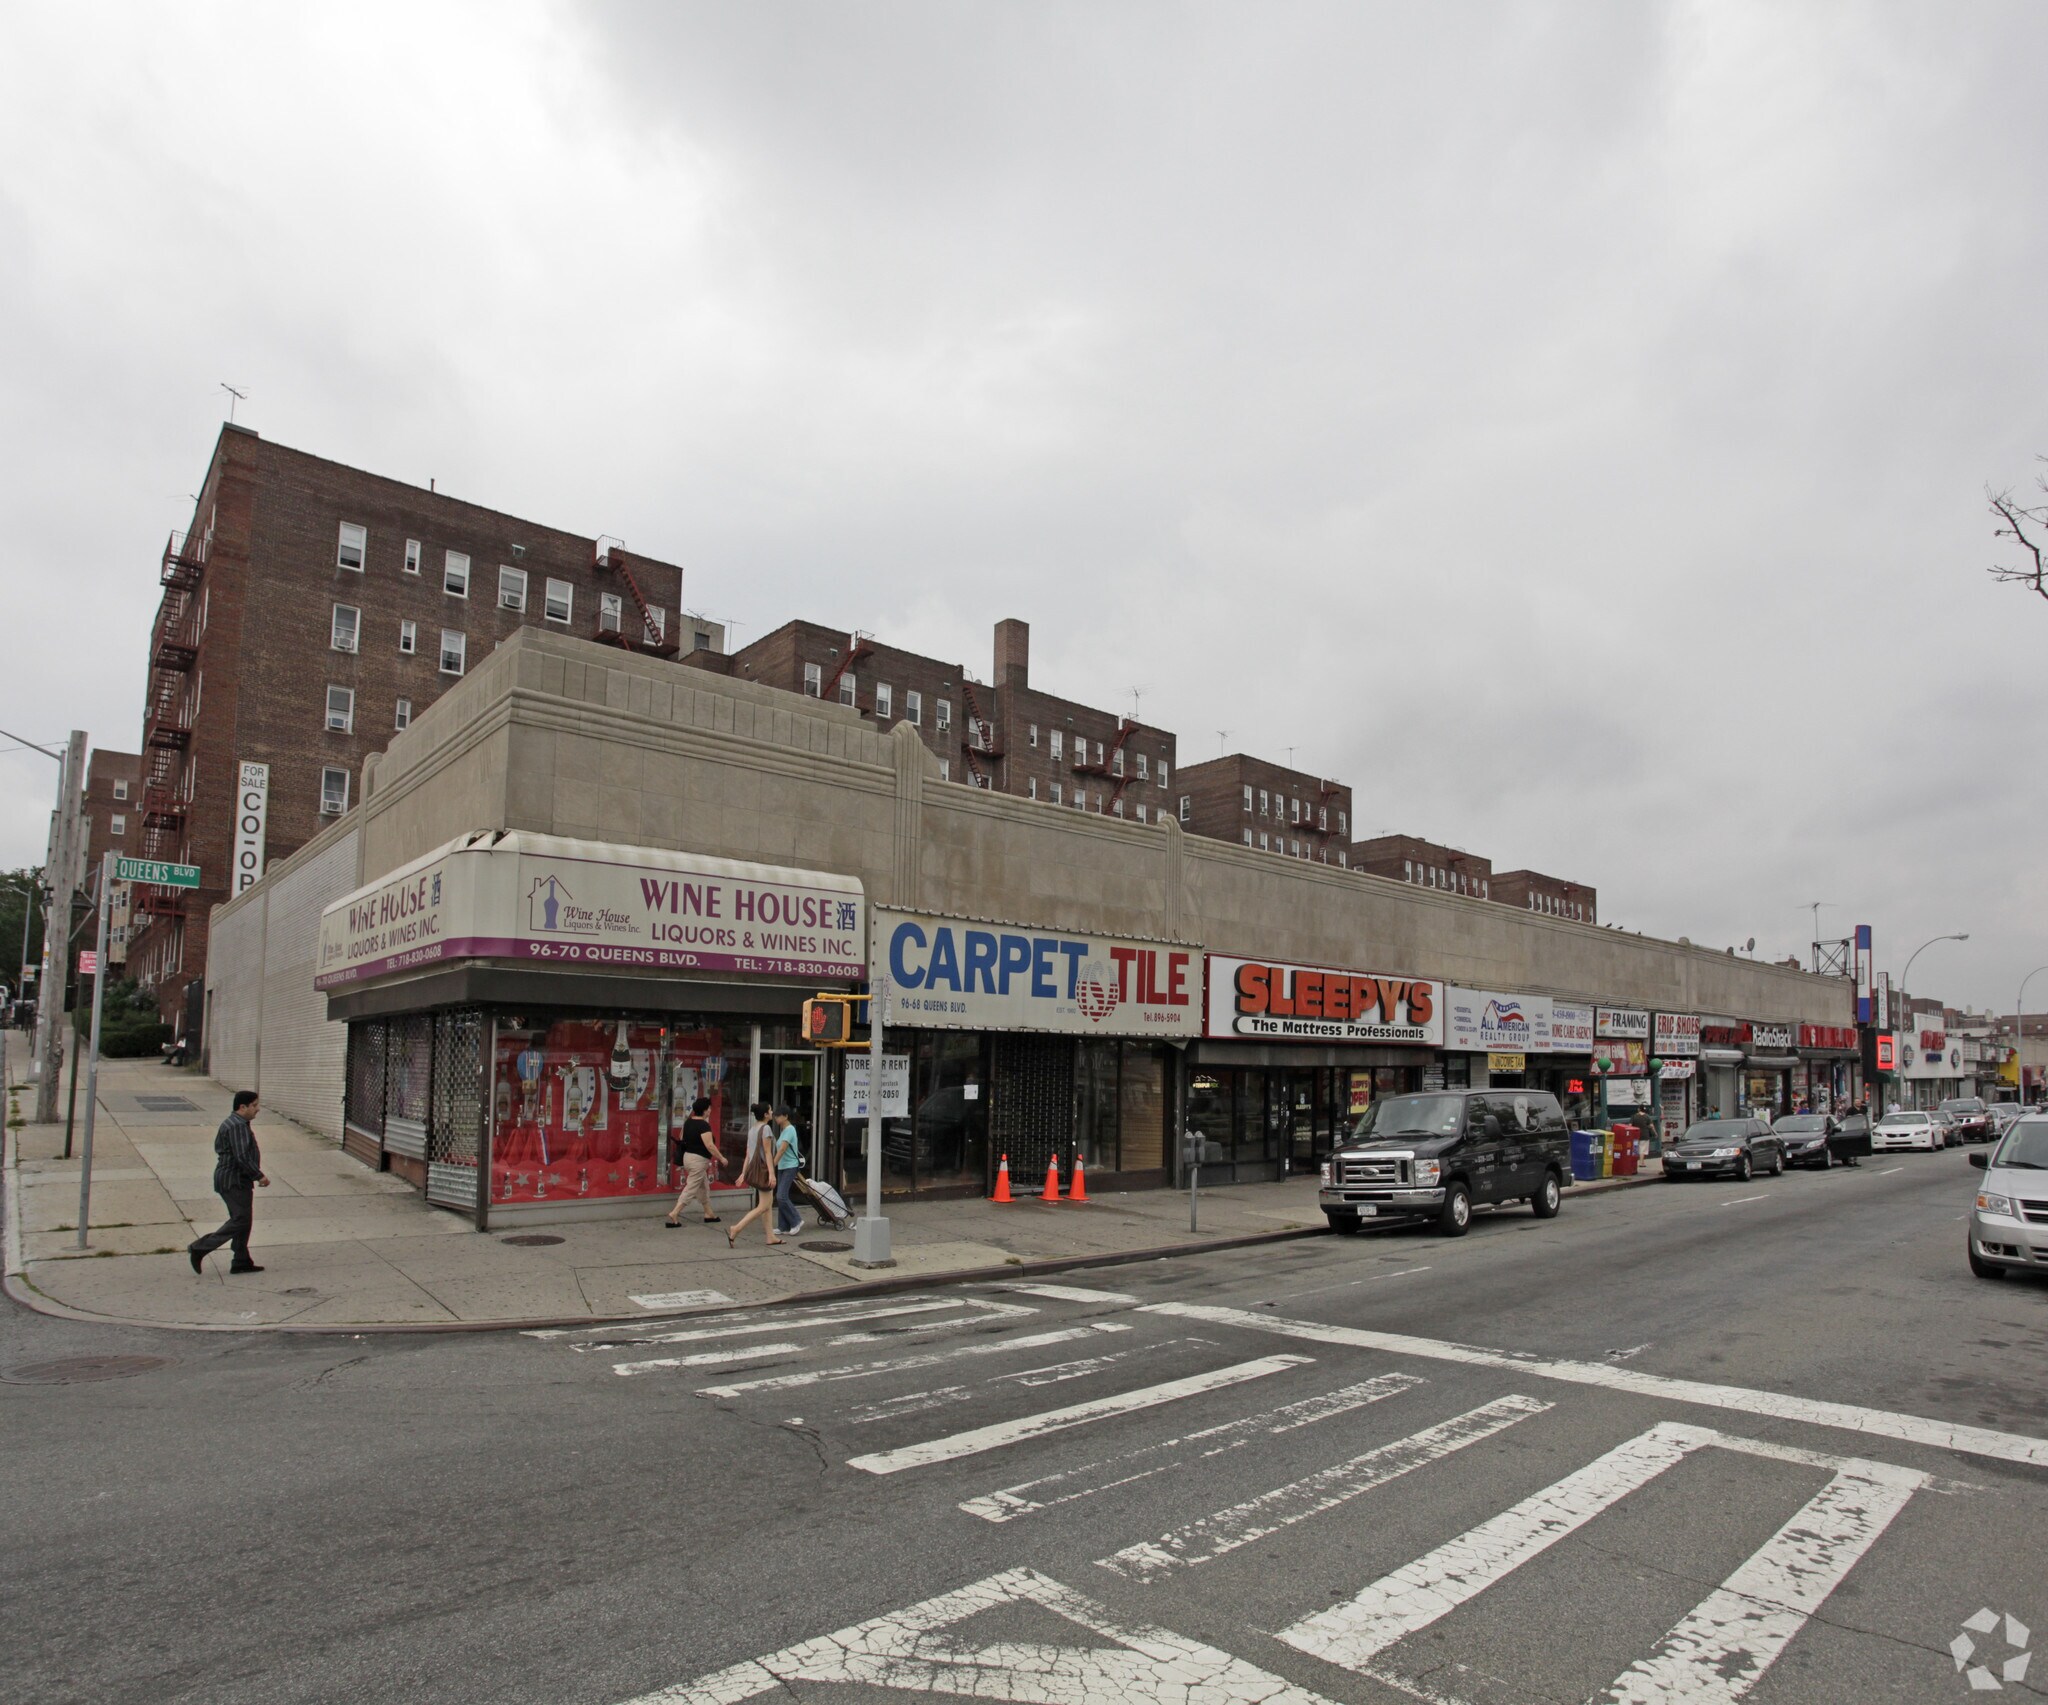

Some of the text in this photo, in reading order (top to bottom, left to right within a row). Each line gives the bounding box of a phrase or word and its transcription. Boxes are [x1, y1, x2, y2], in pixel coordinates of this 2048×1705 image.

[244, 765, 264, 777] FOR
[241, 777, 265, 789] SALE
[120, 860, 195, 881] QUEENS BLVD
[349, 876, 427, 935] WINE HOUSE
[640, 878, 833, 930] WINE HOUSE
[563, 905, 631, 924] Wine House
[836, 900, 856, 931] 酒
[563, 919, 594, 931] Liquors
[595, 921, 602, 930] &
[602, 922, 622, 933] Wines
[347, 935, 378, 960] LIQUORS
[380, 935, 388, 951] &
[389, 923, 417, 949] WINES
[419, 914, 440, 940] INC.
[652, 923, 857, 956] LIQUORS & WINES INC.
[387, 944, 442, 970] TEL: 718-830-0608
[529, 943, 701, 966] 96-70 QUEENS BLVD.
[889, 922, 1189, 1006] CARPET TILE
[734, 957, 860, 977] TEL: 718-830-0608
[328, 971, 345, 984] QUEENS
[1234, 963, 1433, 1024] SLEEPY'S
[901, 998, 967, 1014] 96-68 QUEENS BLVD.
[1252, 1019, 1424, 1039] The Mattress Professionals
[1481, 1016, 1495, 1031] ALL
[1497, 1017, 1530, 1032] AMERICAN
[1612, 1013, 1646, 1029] FRAMING
[1658, 1015, 1674, 1035] ERIC
[1677, 1016, 1700, 1035] SHOES
[1480, 1031, 1505, 1042] REALTY
[1509, 1033, 1530, 1042] GROUP
[1564, 1025, 1575, 1039] CARE
[1576, 1025, 1592, 1040] AGENCY
[1752, 1025, 1792, 1048] RadioShack
[845, 1059, 871, 1070] STORE
[888, 1060, 908, 1070] RENT
